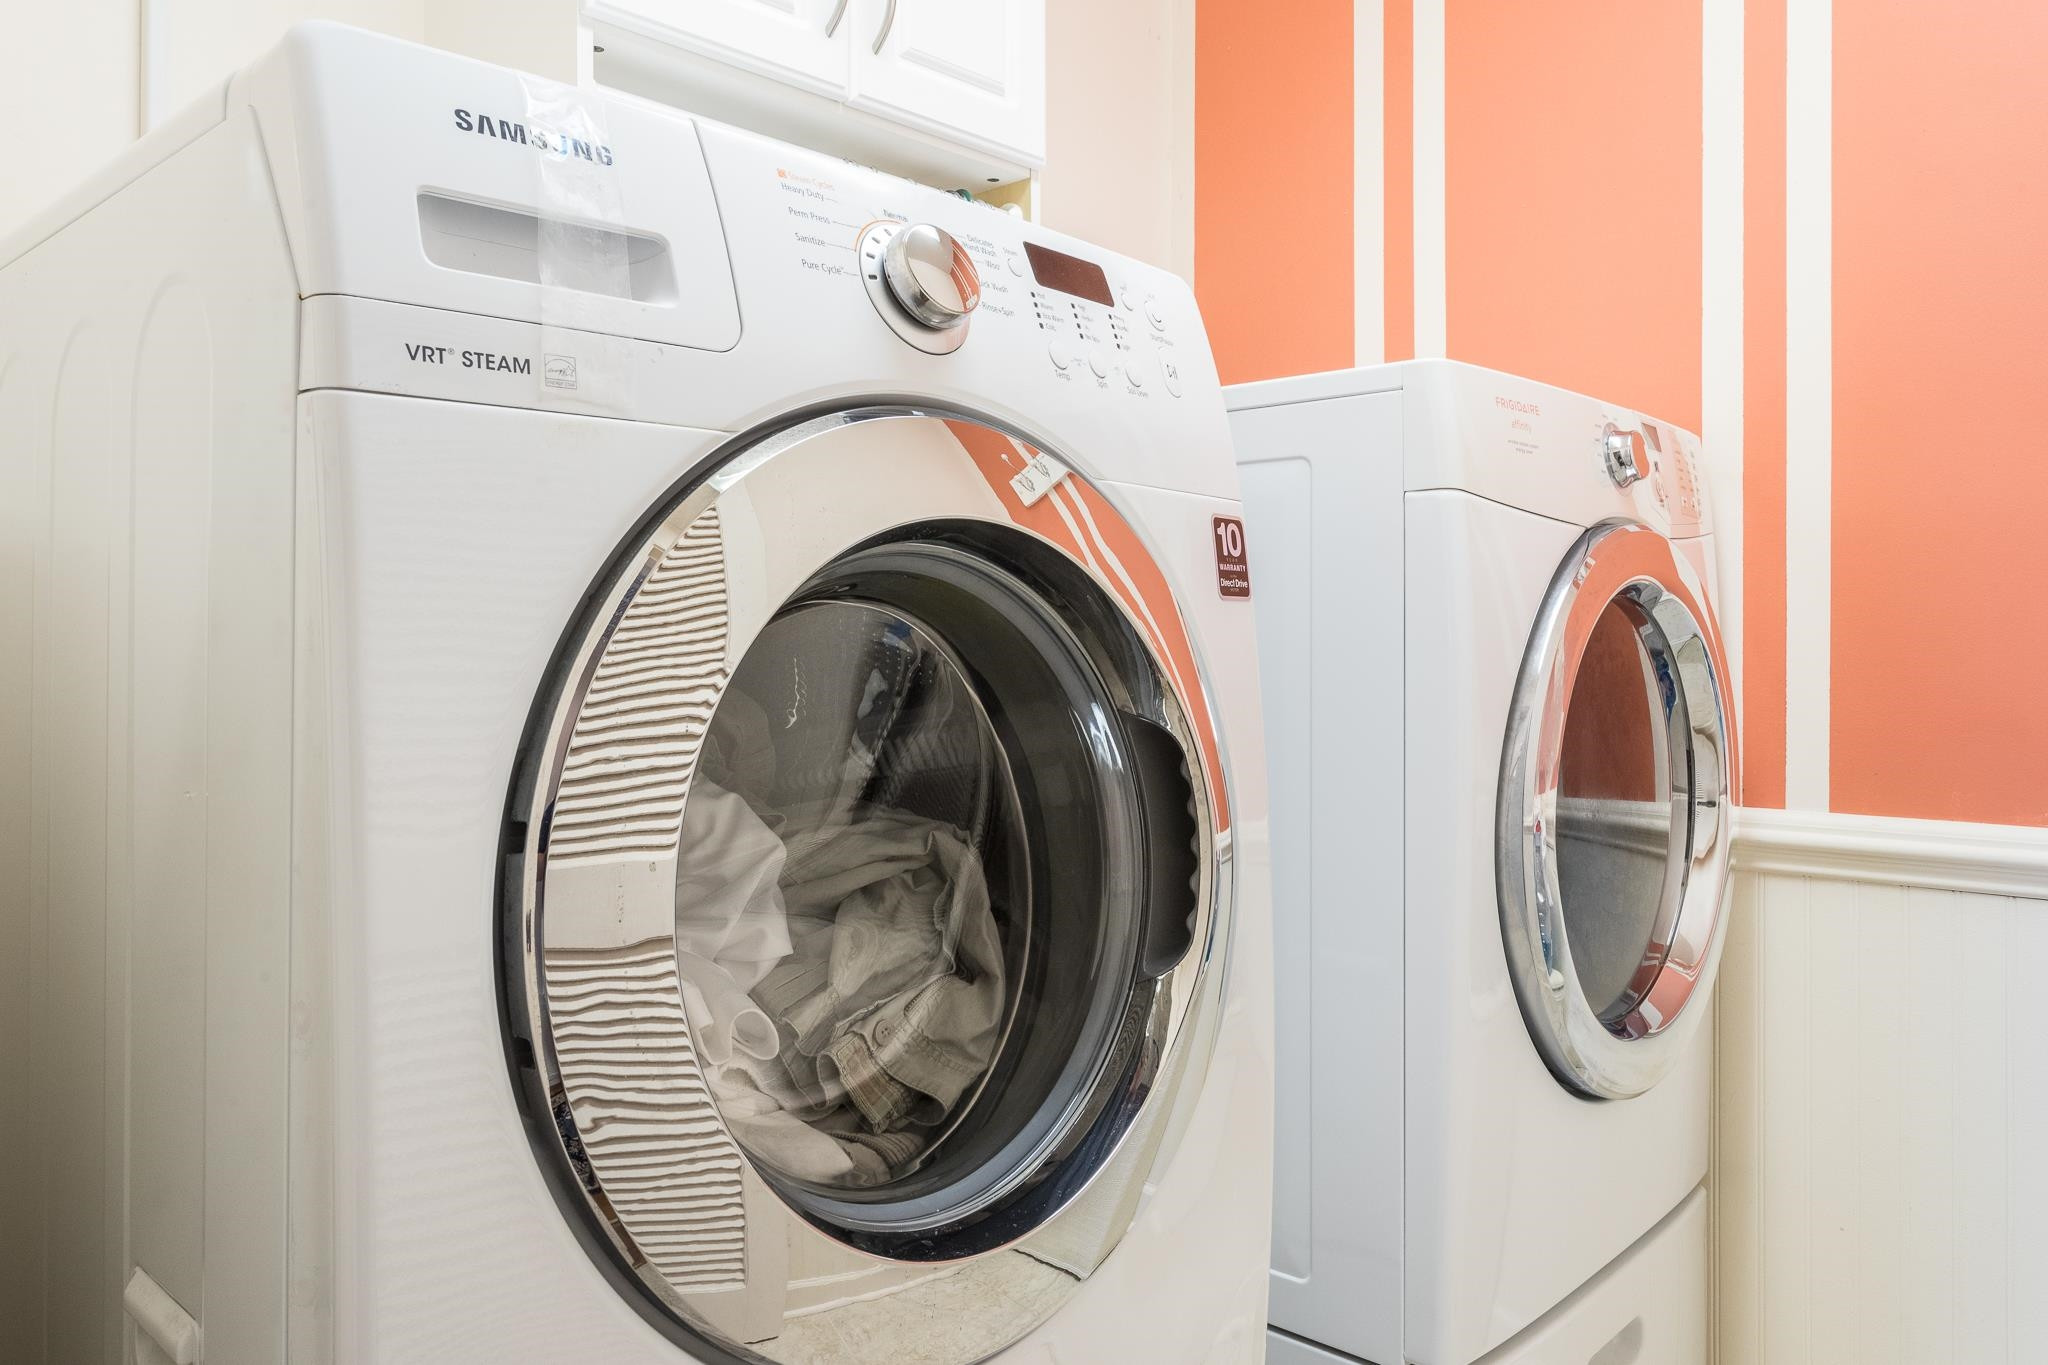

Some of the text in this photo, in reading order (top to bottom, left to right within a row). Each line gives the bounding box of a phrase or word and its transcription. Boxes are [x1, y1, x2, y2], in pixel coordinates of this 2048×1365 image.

[453, 108, 614, 167] SAMSUNG
[781, 182, 825, 202] Heavy Duty
[788, 206, 831, 225] Perm Press
[794, 232, 826, 247] Sanitize
[801, 258, 819, 271] Pure
[462, 351, 531, 375] STEAM
[1495, 397, 1540, 416] FRIGIDAIRE
[1217, 522, 1241, 557] 10
[1220, 564, 1246, 572] WARRANTY
[1220, 578, 1248, 589] Direct Drive
